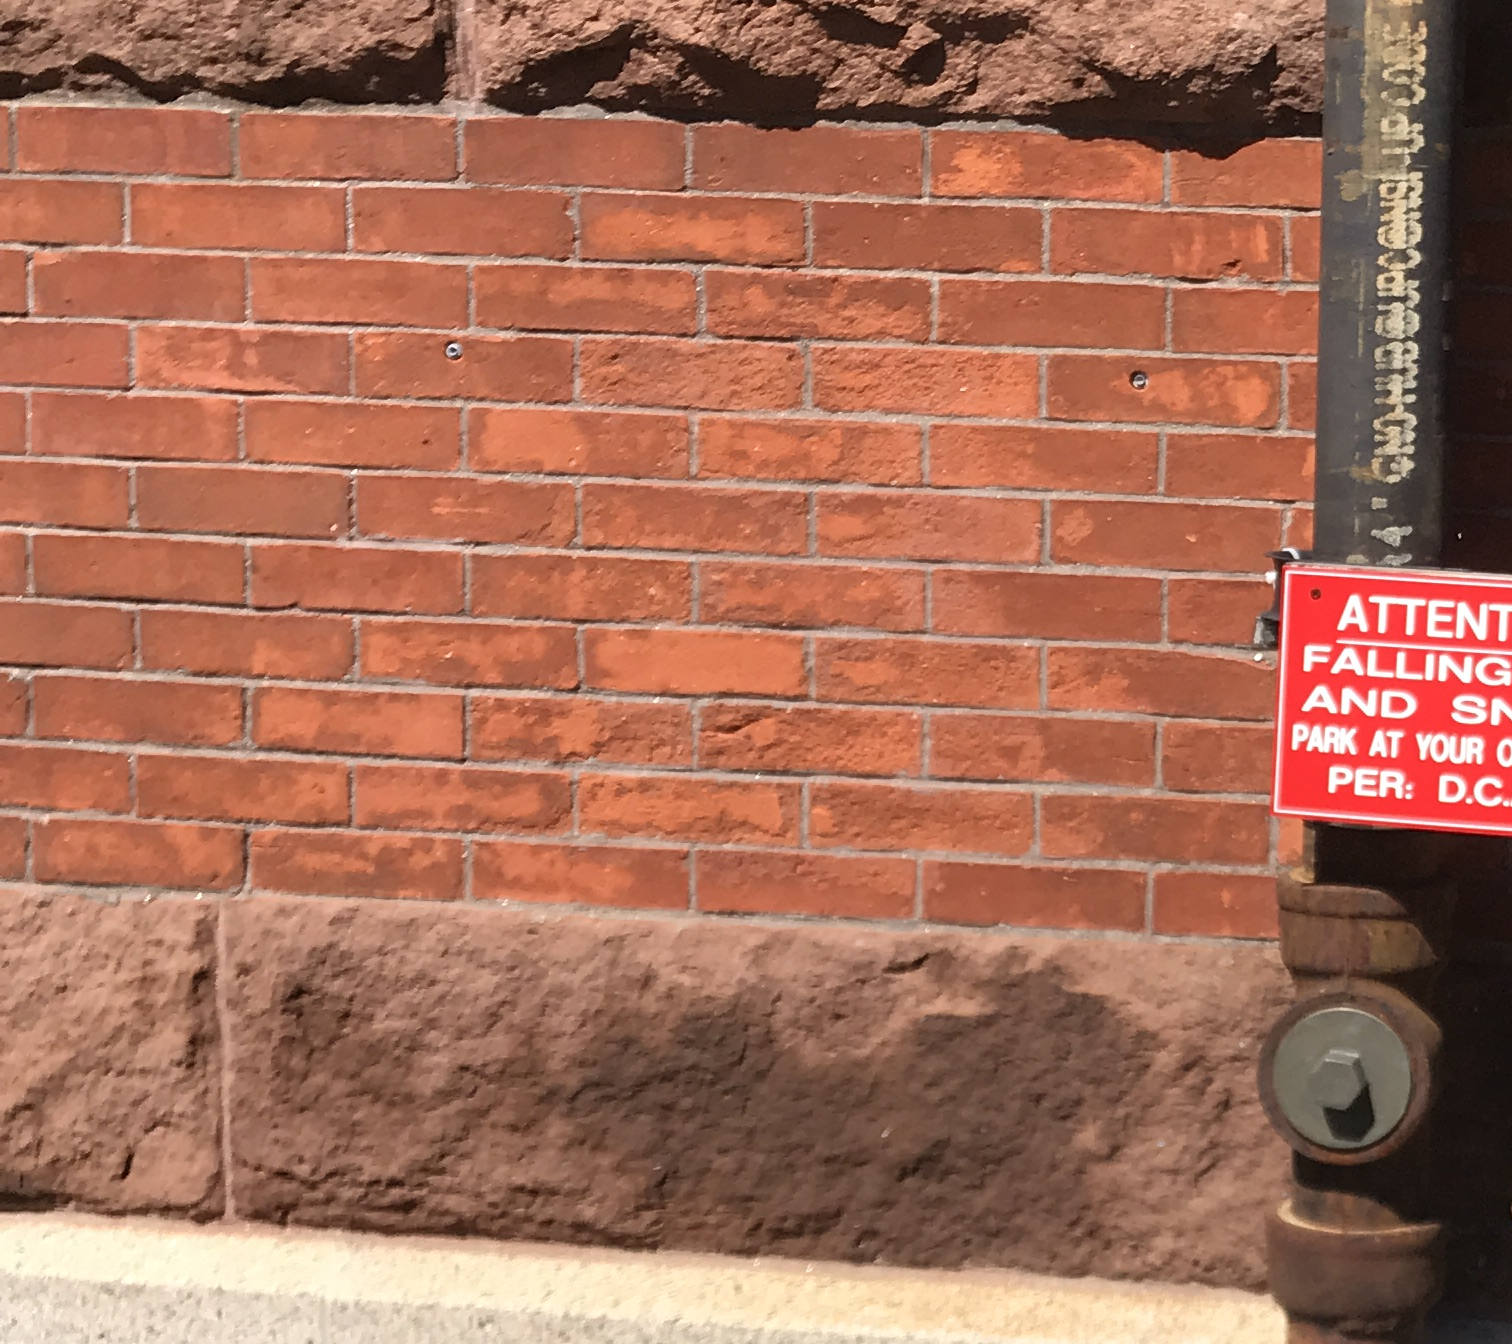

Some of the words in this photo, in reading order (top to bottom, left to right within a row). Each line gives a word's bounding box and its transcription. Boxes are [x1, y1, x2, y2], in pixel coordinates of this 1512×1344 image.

[1303, 645, 1512, 687] FALLING
[1301, 685, 1417, 719] AND
[1291, 724, 1357, 755] PARK
[1369, 730, 1405, 758] AT
[1416, 733, 1483, 764] YOUR
[1328, 767, 1414, 800] PER:
